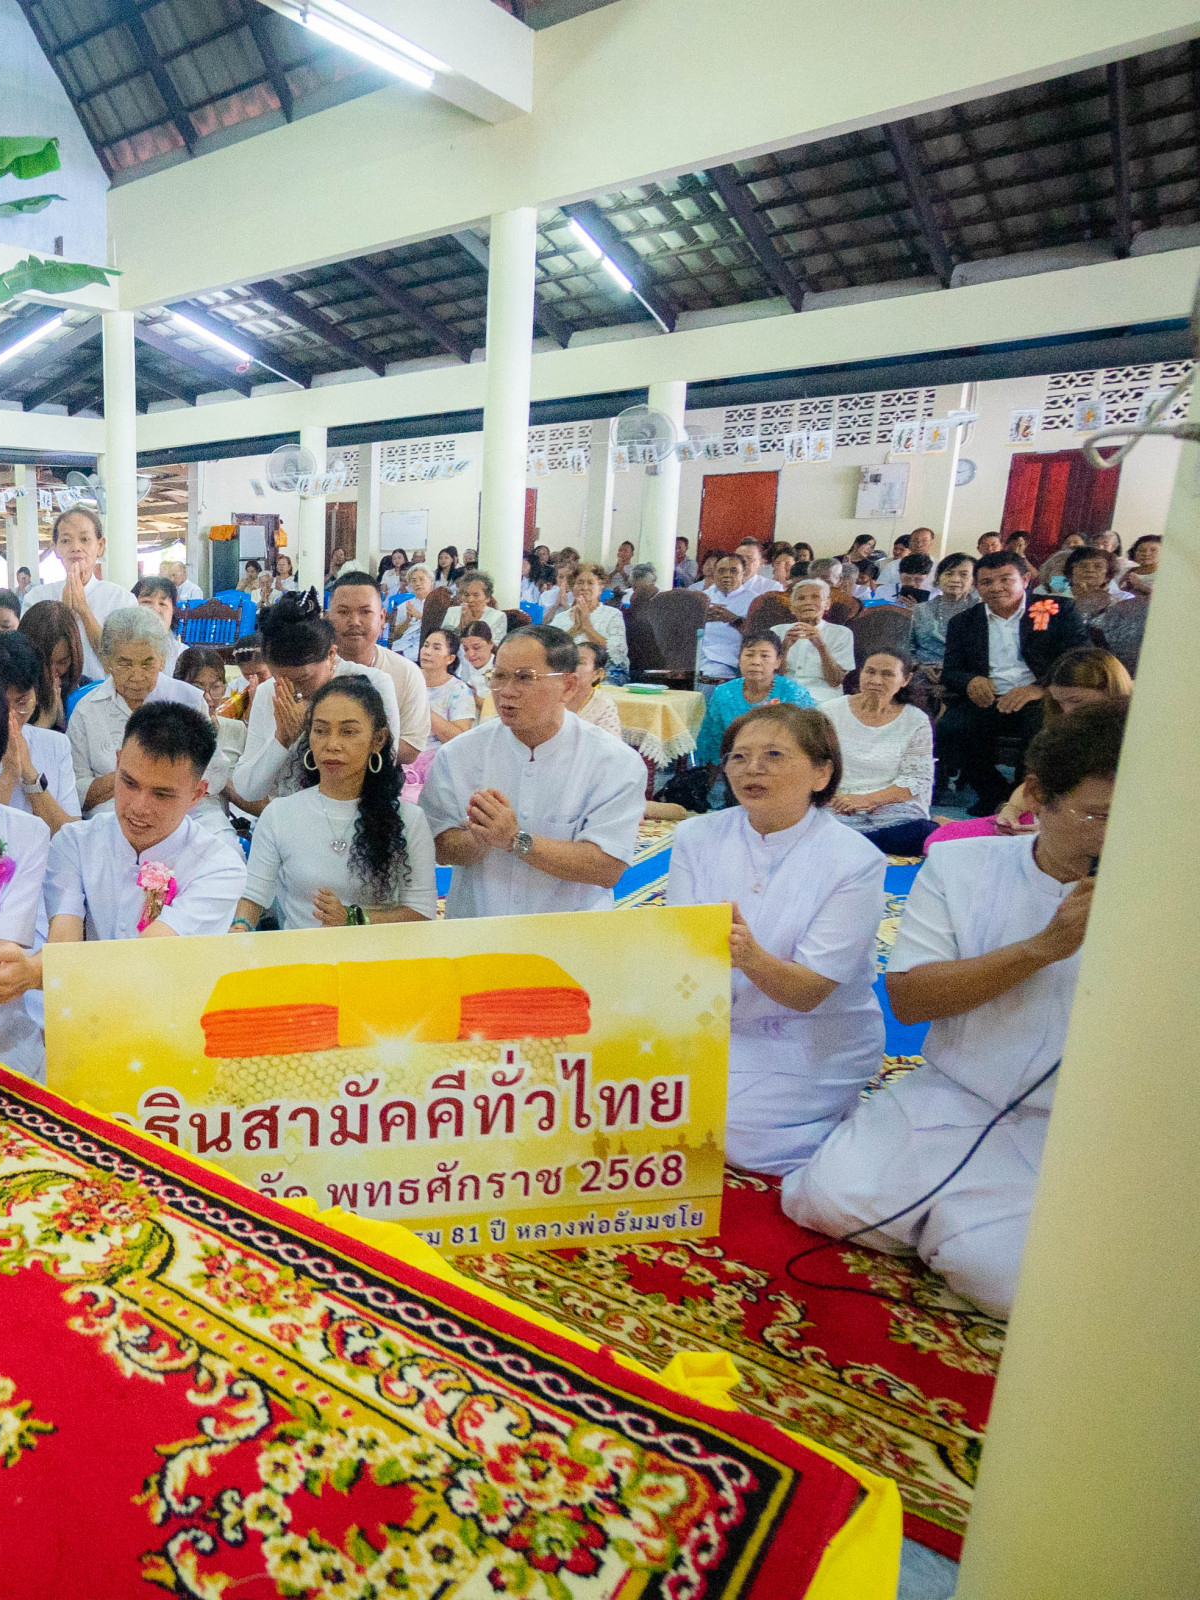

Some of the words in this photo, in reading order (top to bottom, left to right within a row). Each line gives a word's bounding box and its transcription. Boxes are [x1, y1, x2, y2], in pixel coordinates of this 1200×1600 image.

[116, 1050, 684, 1154] ฐินสามัคคีทั่วไทย
[327, 1160, 563, 1215] พทธศักราช
[580, 1153, 684, 1193] 2568
[451, 1226, 479, 1244] 81
[490, 1218, 506, 1242] ปี
[516, 1203, 704, 1240] หลวงพ่อธัมมชโย
